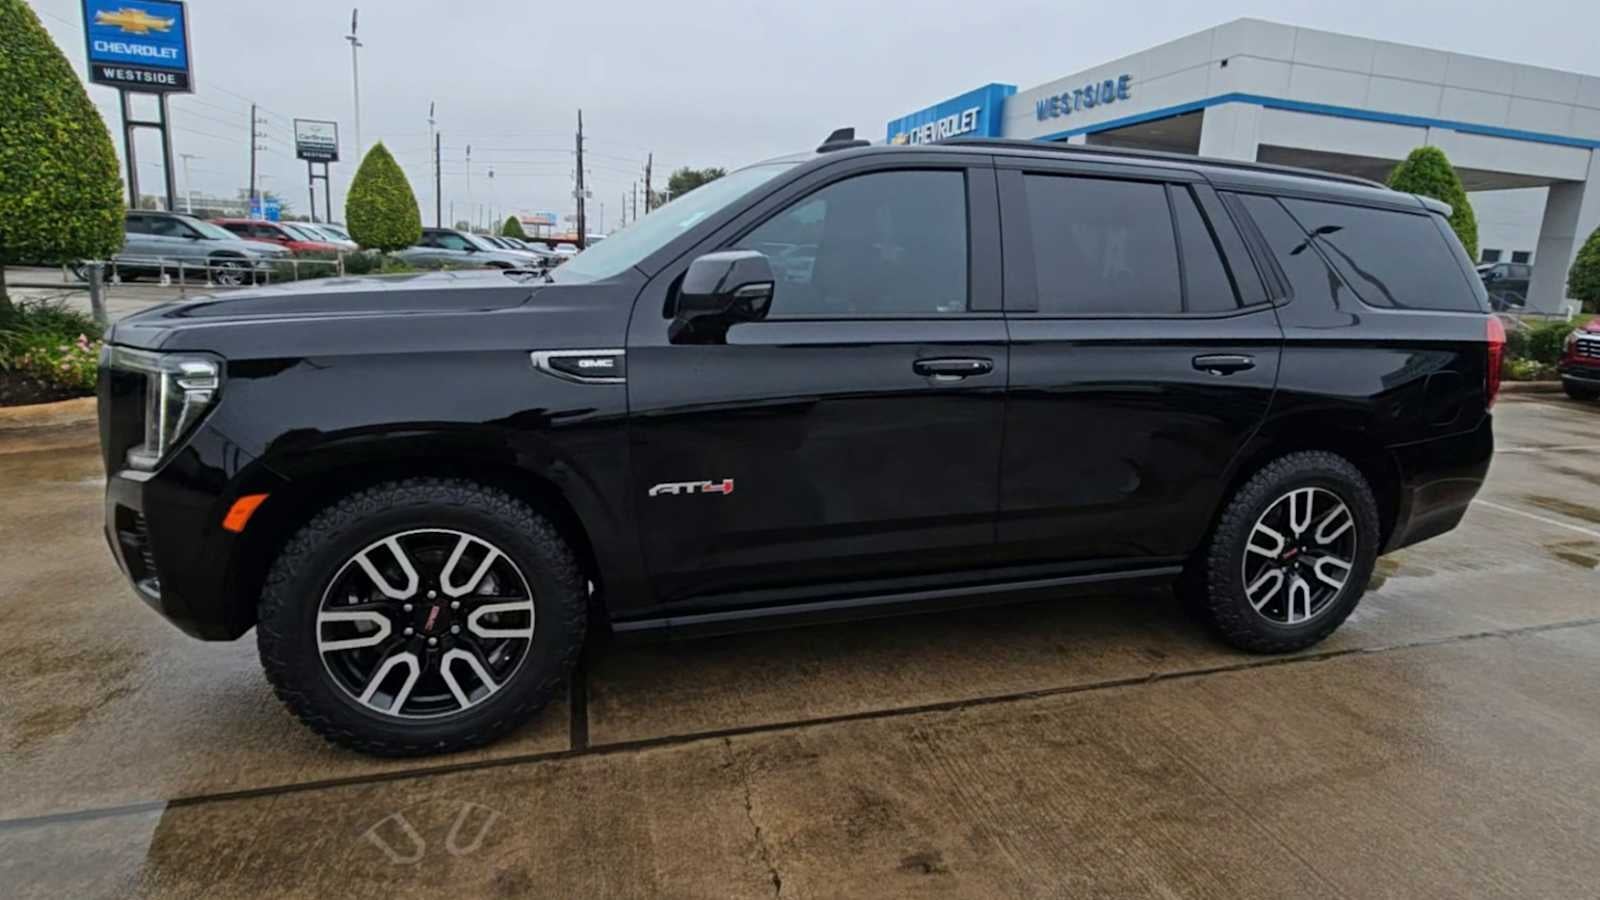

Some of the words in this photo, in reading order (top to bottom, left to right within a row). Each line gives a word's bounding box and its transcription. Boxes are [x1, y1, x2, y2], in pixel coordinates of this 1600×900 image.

[93, 40, 179, 59] CHEVROLET
[103, 67, 177, 84] WESTSIDE
[1036, 74, 1133, 121] WESTSIDE
[911, 106, 980, 145] CHEVROLET
[578, 359, 614, 367] GMC
[649, 479, 734, 496] AT4
